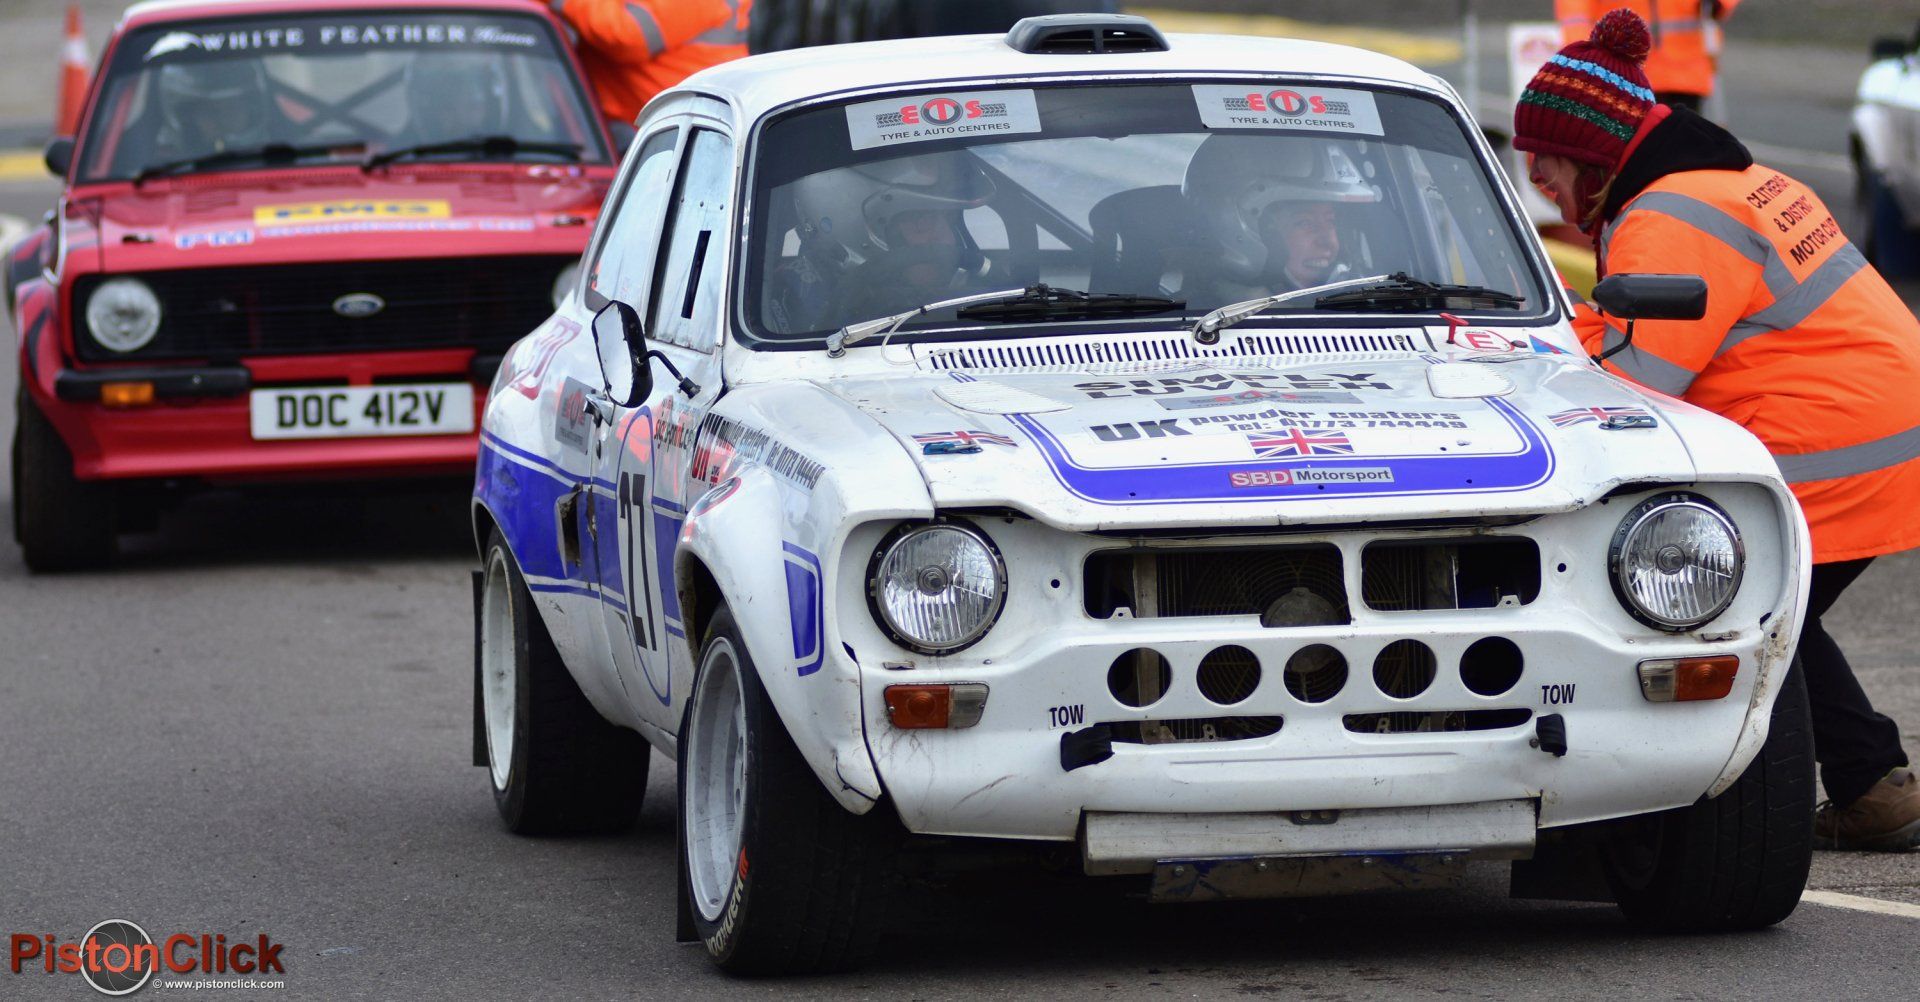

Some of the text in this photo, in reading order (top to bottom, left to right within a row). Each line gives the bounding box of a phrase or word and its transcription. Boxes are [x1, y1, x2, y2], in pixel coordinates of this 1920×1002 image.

[201, 27, 304, 51] WHITE
[320, 24, 468, 45] FEATHER
[899, 97, 984, 125] ETS
[1246, 89, 1328, 116] ETS
[881, 131, 911, 141] TYRE
[924, 126, 955, 136] AUTO
[958, 122, 1011, 133] CENTRES
[1272, 117, 1302, 125] AUTO
[1305, 119, 1355, 129] CENTRES
[1773, 218, 1789, 233] &
[1789, 228, 1830, 266] MOTOR
[1073, 373, 1376, 391] SIMPLY
[276, 390, 445, 429] DOC 412V
[1089, 408, 1462, 442] UK powder coaters
[1223, 418, 1469, 431] Tel: 01773 744449
[1231, 469, 1391, 487] SBD Motorsport
[619, 471, 658, 652] 27
[1542, 684, 1576, 704] TOW
[1049, 705, 1085, 728] TOW
